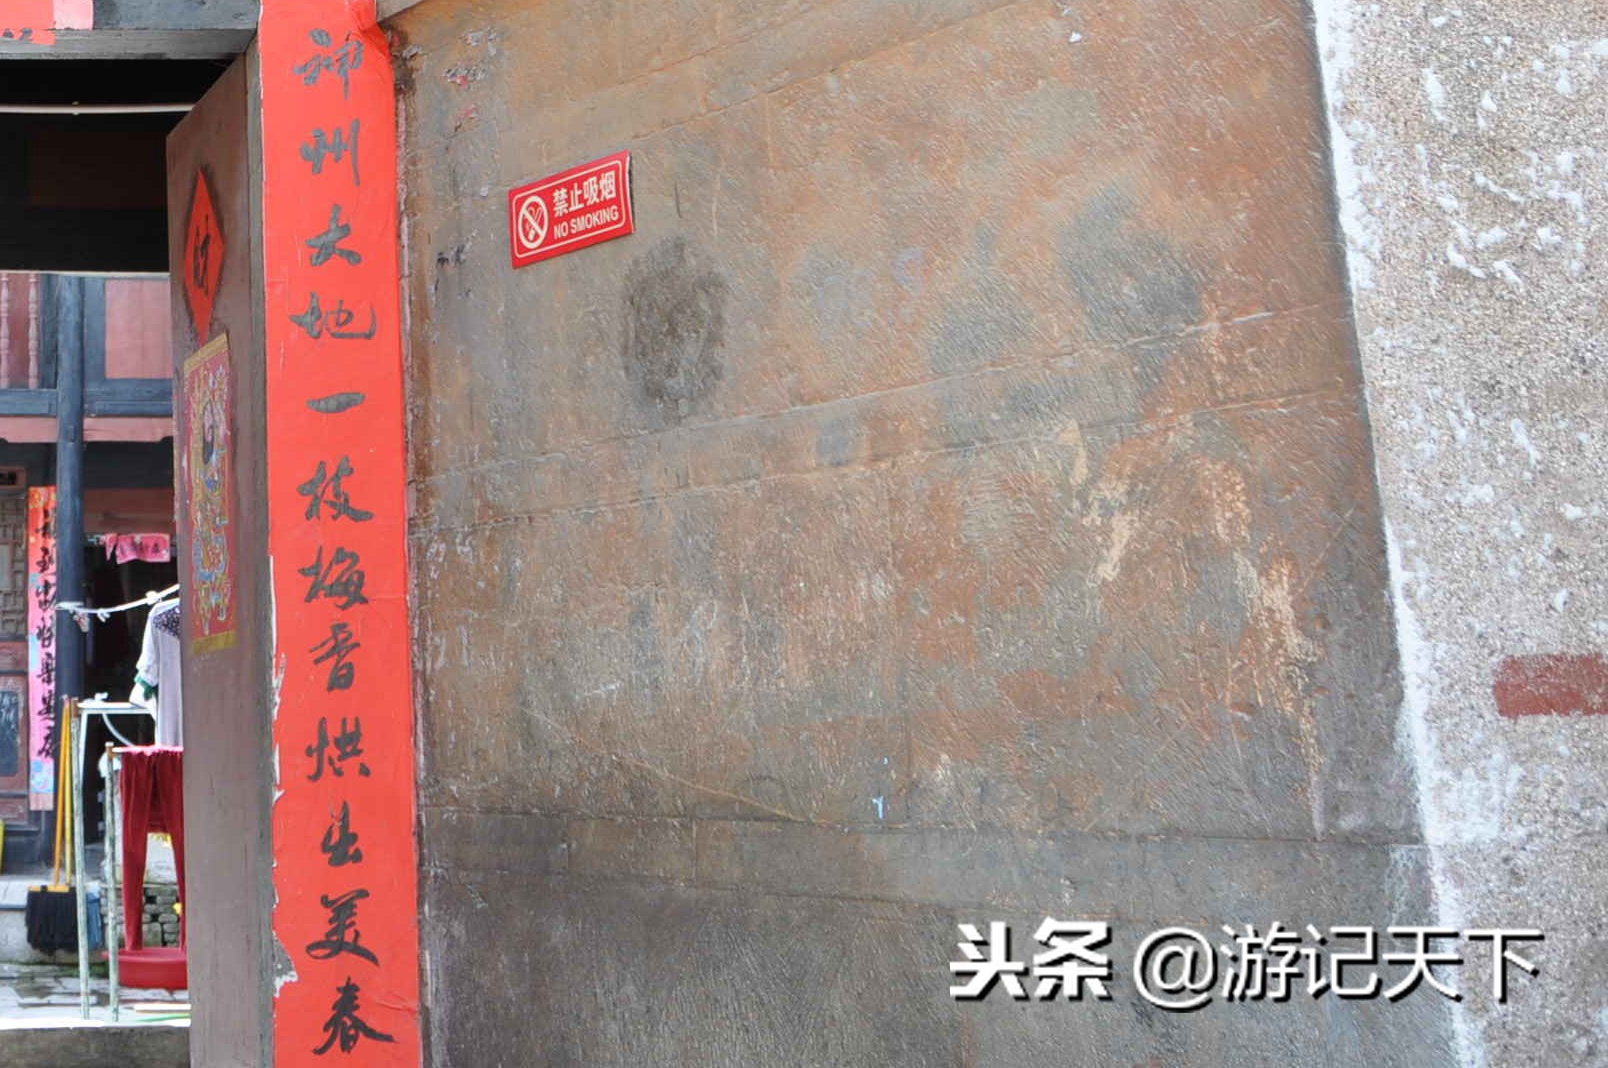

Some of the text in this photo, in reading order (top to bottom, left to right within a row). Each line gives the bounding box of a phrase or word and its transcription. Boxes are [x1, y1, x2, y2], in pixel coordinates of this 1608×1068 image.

[553, 171, 617, 218] 禁止吸烟
[554, 205, 619, 241] NO SMOKING
